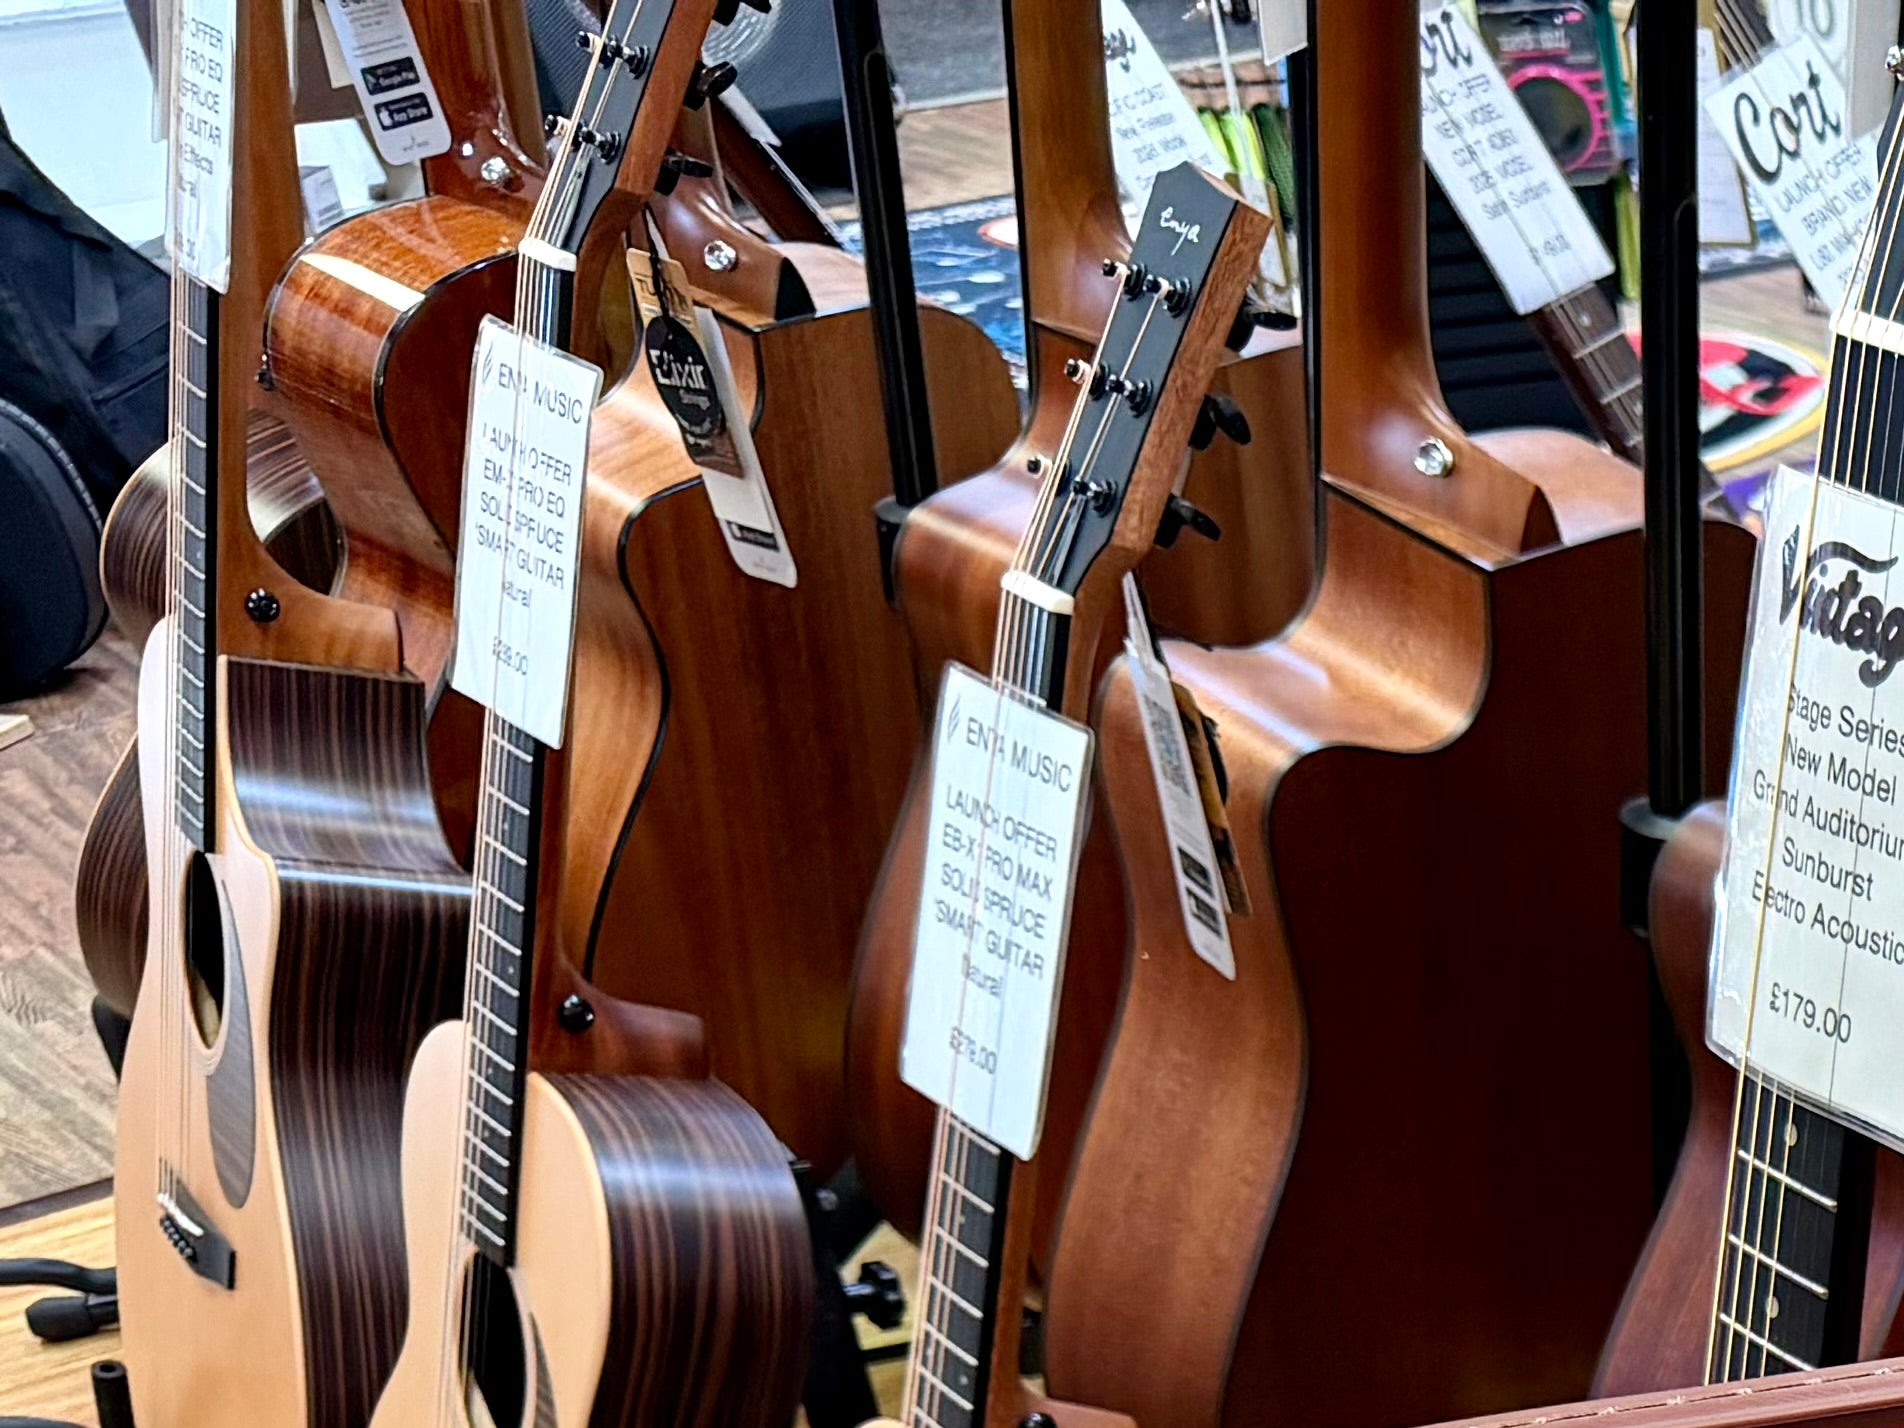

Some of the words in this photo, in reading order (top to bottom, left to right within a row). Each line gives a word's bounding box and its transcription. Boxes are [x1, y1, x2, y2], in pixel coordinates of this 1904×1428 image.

[1733, 58, 1841, 187] Cort
[1160, 205, 1201, 257] Enya
[648, 348, 707, 391] Elixir
[532, 380, 583, 425] MUSIC
[1010, 740, 1073, 793] MUSIC
[1785, 732, 1822, 777] New
[1826, 752, 1897, 806] Model
[1753, 768, 1800, 819] Grnd
[1002, 815, 1058, 864] OFFER
[1015, 862, 1053, 901] MAX
[1782, 835, 1874, 902] Sunburst
[983, 886, 1047, 940] SPRUCE
[1752, 870, 1806, 925] Eectro
[1769, 981, 1852, 1044] £179.00
